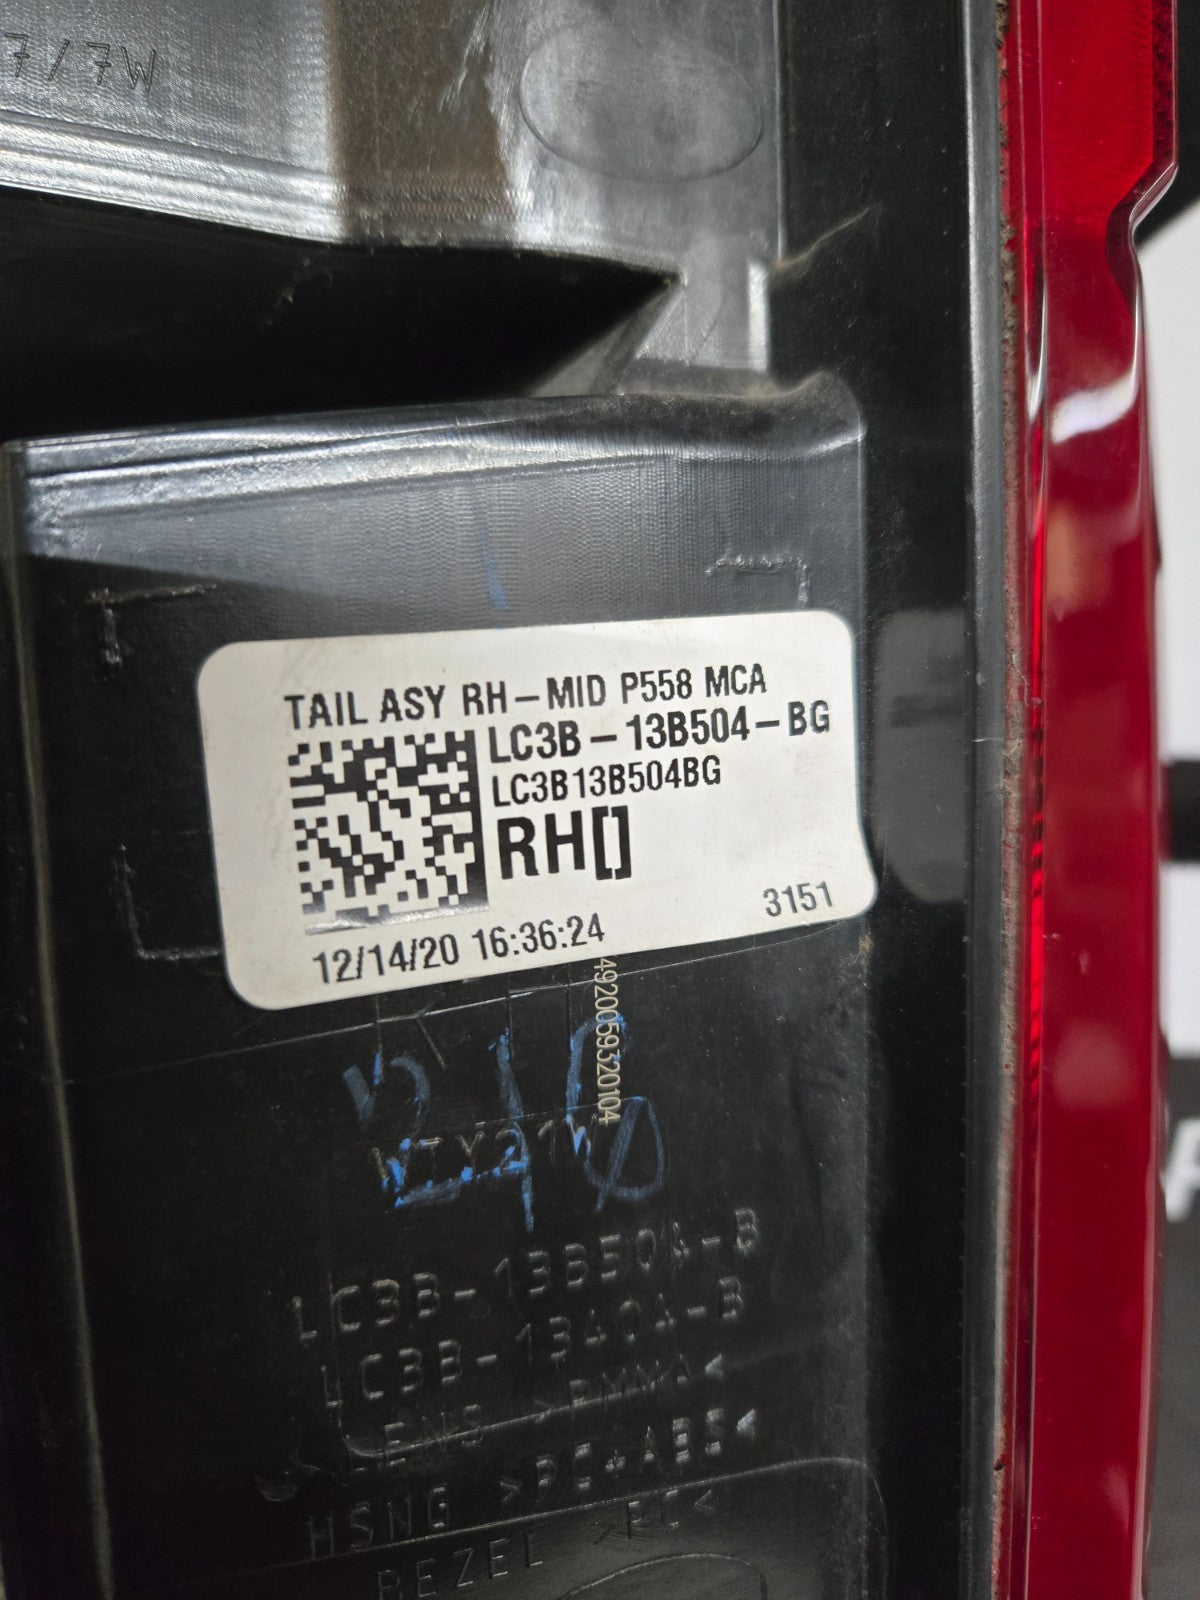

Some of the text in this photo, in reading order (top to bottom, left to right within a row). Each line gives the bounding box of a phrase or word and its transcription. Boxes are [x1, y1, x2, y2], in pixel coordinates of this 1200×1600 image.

[284, 694, 367, 730] TAIL
[379, 684, 447, 722] ASY
[620, 669, 693, 706] P558
[705, 662, 769, 695] MCA
[492, 754, 722, 807] LC3B13B504BG
[762, 880, 834, 915] 3151
[311, 913, 608, 986] 12/14/20 16:36:24
[592, 956, 624, 1127] 4920059320104
